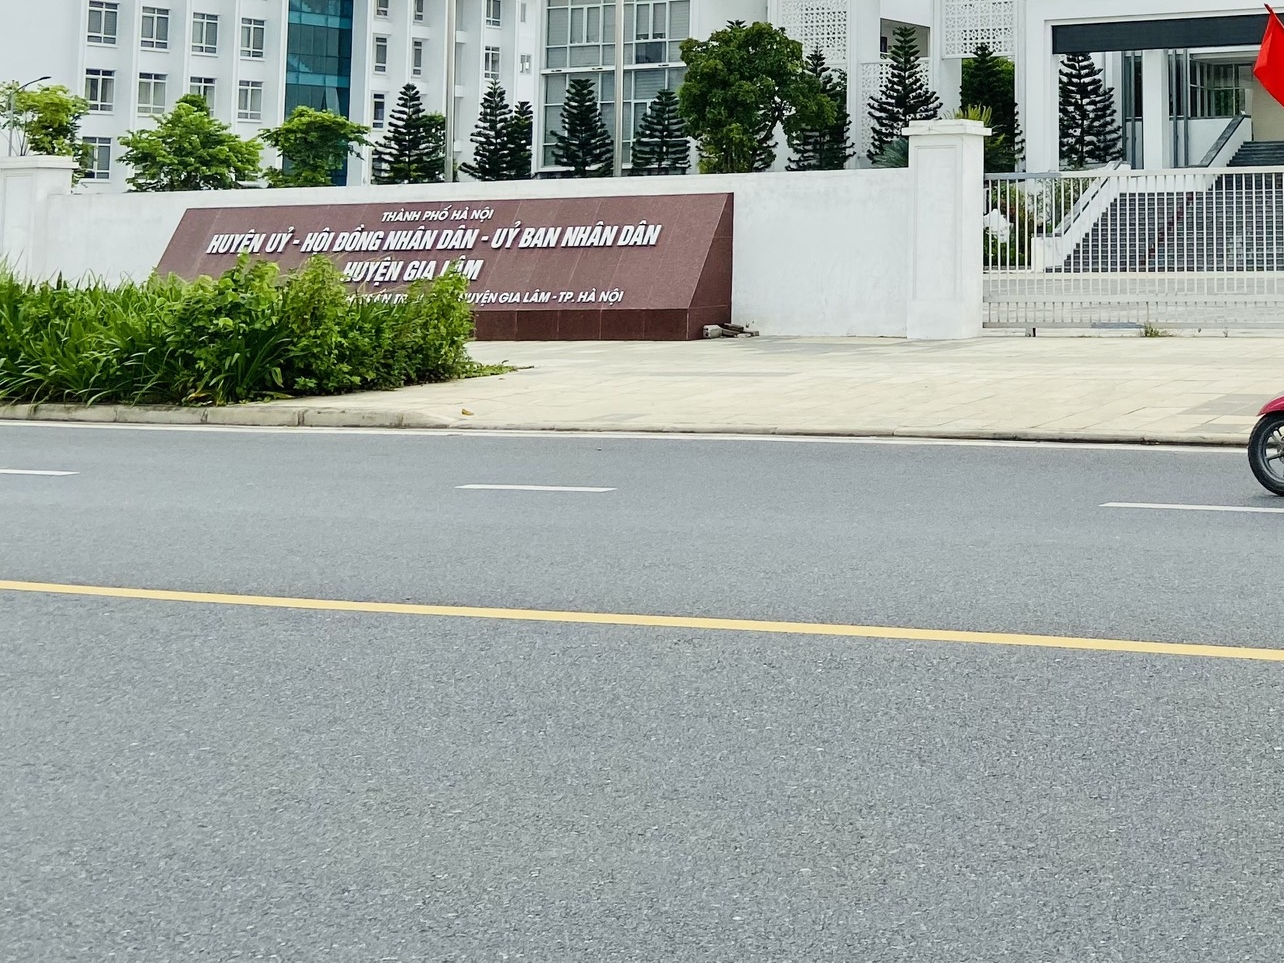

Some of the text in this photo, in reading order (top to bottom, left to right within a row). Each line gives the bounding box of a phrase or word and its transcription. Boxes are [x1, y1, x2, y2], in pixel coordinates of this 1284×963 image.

[381, 205, 494, 223] THÀNH PHỐ HÀ NỘI
[265, 226, 295, 254] UỶ
[300, 227, 336, 255] HỘI
[332, 224, 385, 252] ĐỒNG
[382, 225, 438, 251] NHÂN
[436, 224, 480, 251] DÂN
[490, 220, 522, 249] UỶ
[518, 226, 562, 248] BAN
[560, 220, 618, 248] NHÂN
[617, 219, 662, 247] DÂN
[340, 256, 404, 287] HUYỆN
[402, 259, 438, 283] GIA
[498, 291, 521, 304] GIA
[522, 288, 552, 304] LÂM
[557, 291, 575, 304] TP.
[577, 288, 597, 303] HÀ
[598, 287, 624, 306] NỘI
